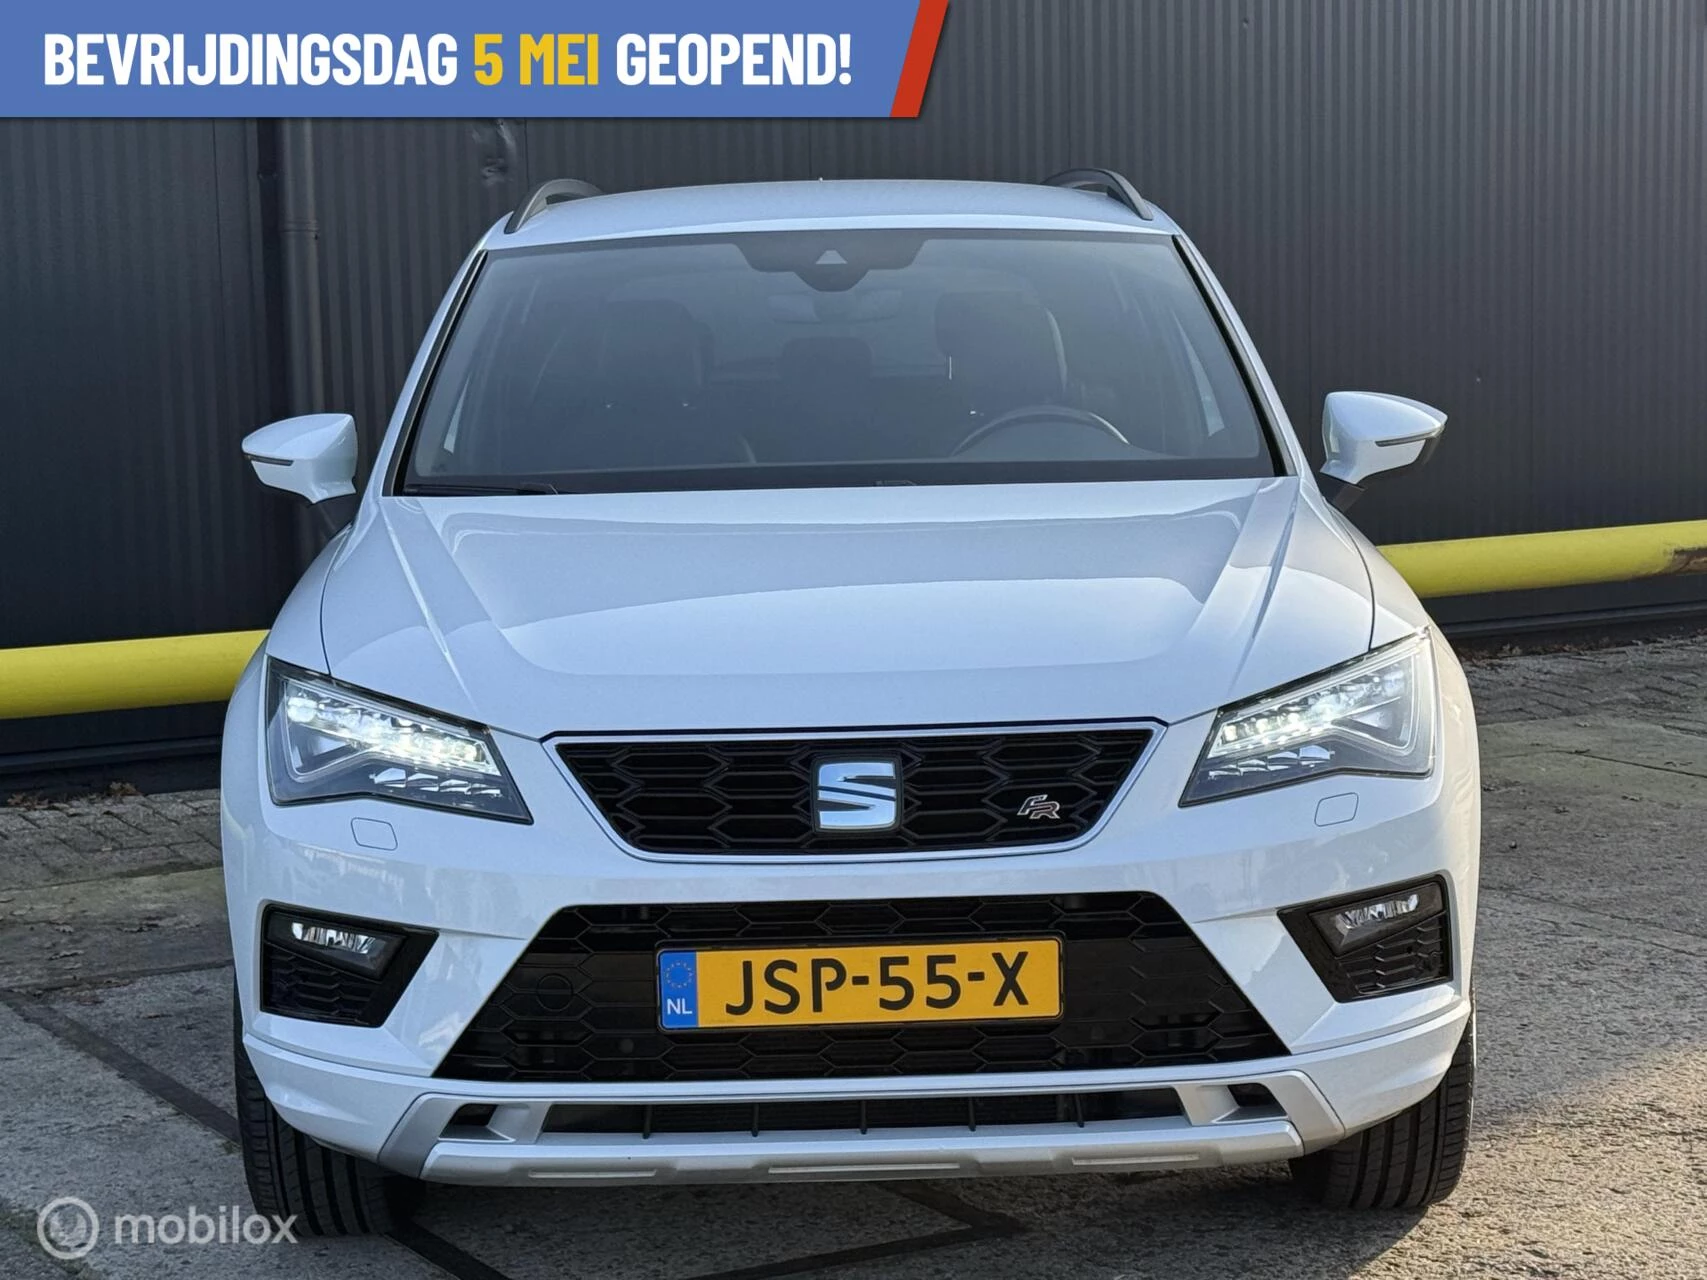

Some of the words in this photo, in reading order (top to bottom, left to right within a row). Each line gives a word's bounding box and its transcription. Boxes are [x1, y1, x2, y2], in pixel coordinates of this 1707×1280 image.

[1016, 794, 1061, 820] FR
[725, 951, 1029, 1016] JSP-55-X
[666, 998, 693, 1015] NL
